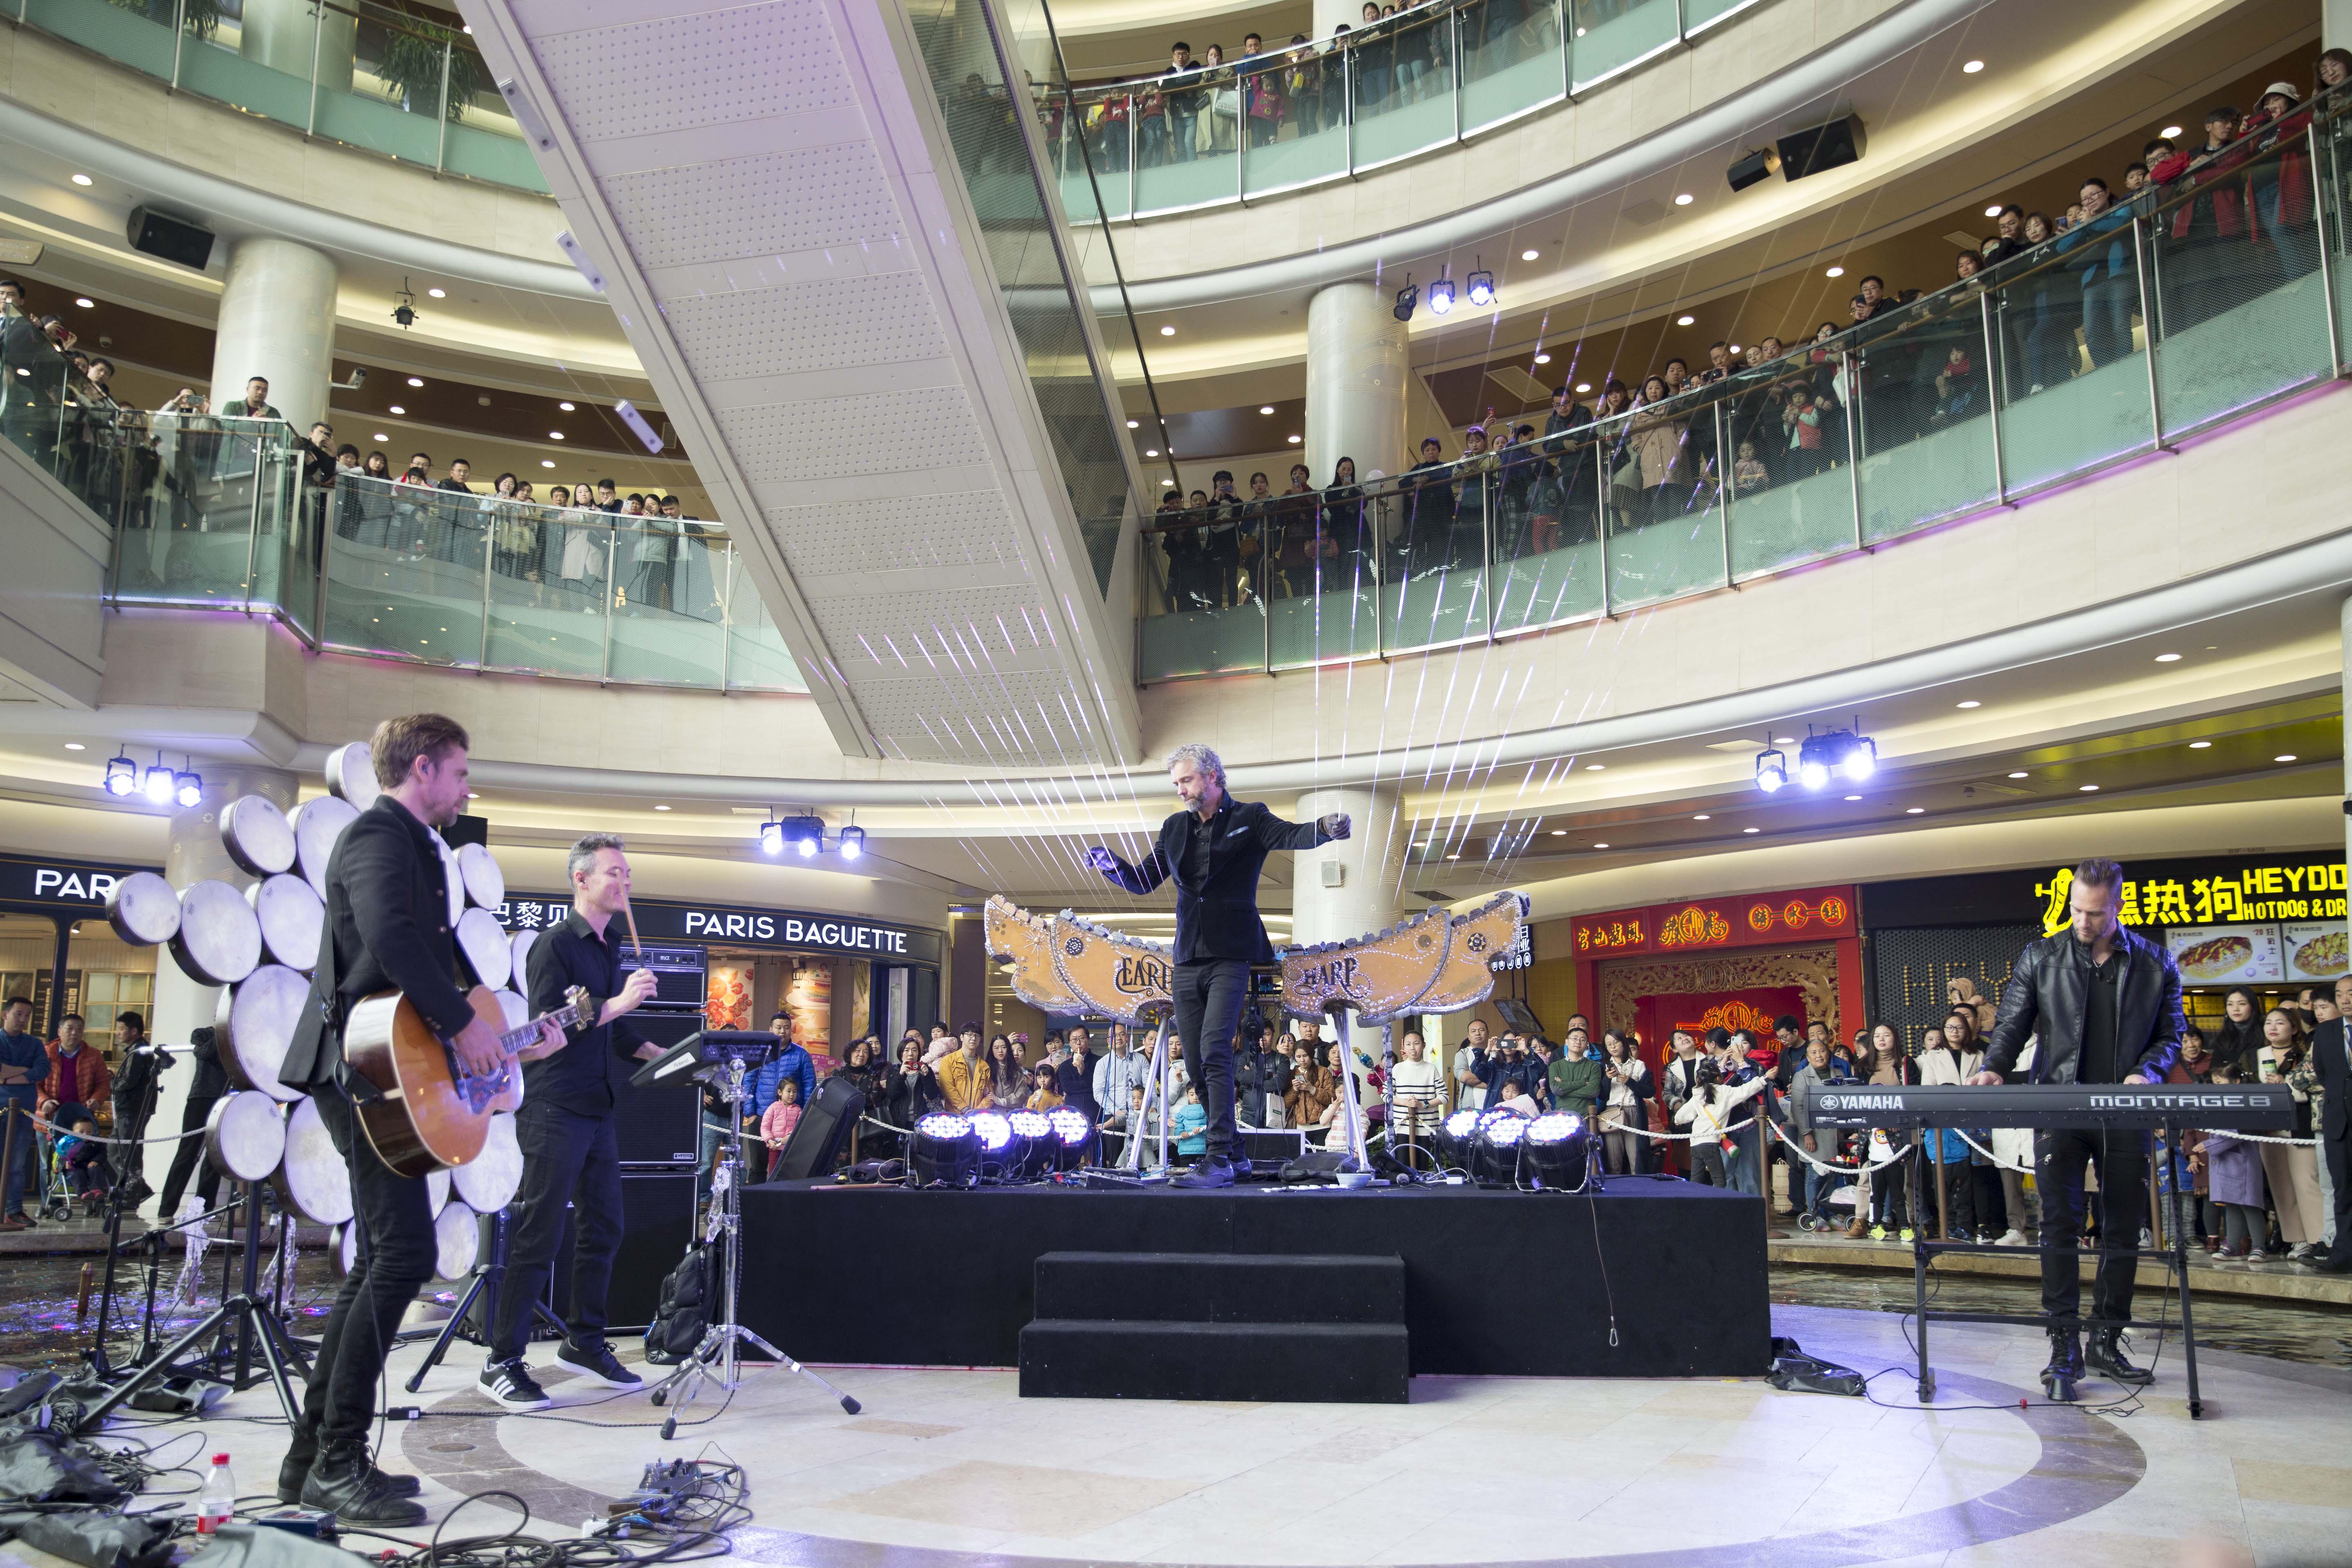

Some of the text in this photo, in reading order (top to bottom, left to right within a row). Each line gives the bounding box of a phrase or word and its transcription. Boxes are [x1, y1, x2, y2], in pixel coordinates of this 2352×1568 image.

[2243, 900, 2308, 920] HOTDOG
[2312, 899, 2324, 917] &
[686, 912, 907, 953] PARIS BAGUETTE
[1116, 955, 1173, 997] EART
[674, 1058, 689, 1067] Roland
[1840, 1096, 1903, 1109] YAMAHA
[2090, 1096, 2270, 1107] MONTAGE 8
